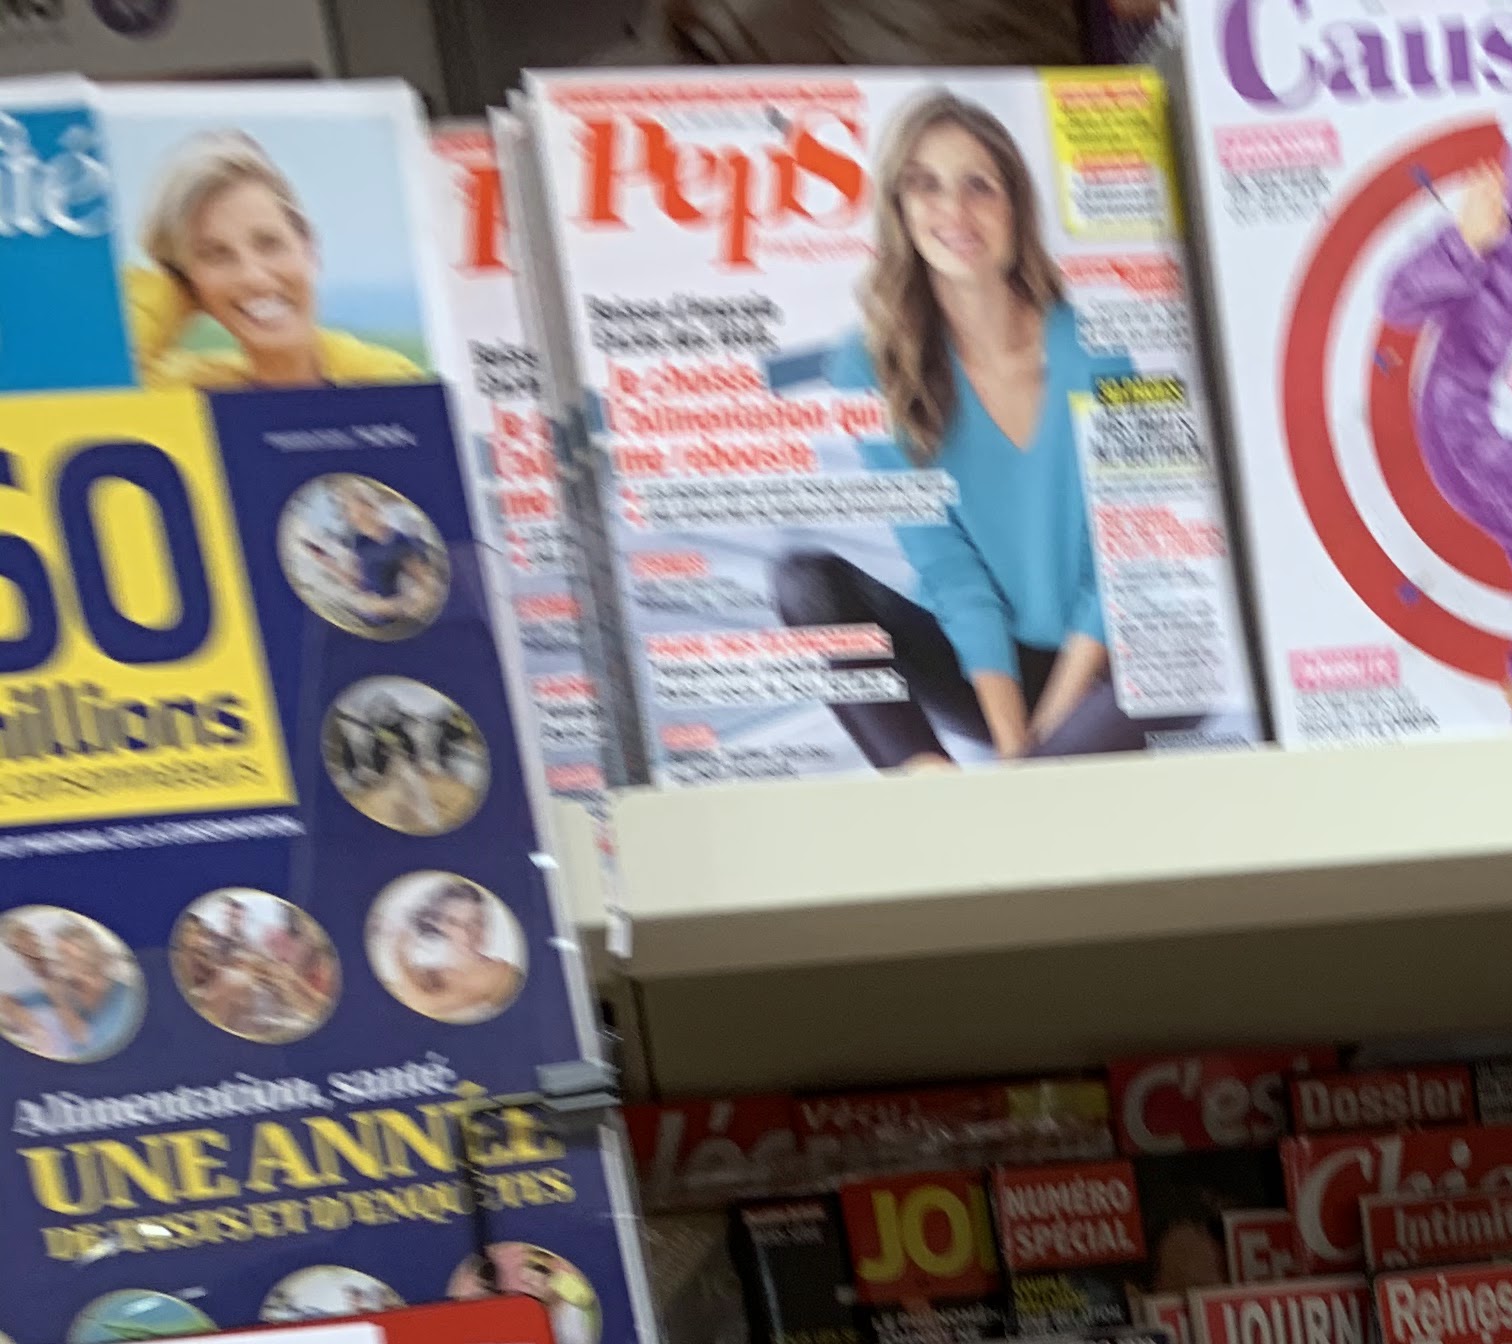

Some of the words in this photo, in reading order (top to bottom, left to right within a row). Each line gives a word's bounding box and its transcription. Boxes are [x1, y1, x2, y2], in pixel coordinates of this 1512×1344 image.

[1302, 1073, 1465, 1126] Dossier
[20, 1122, 241, 1214] UNE
[1003, 1175, 1130, 1218] NUMÉRO
[1015, 1221, 1134, 1262] SPÉCIAL
